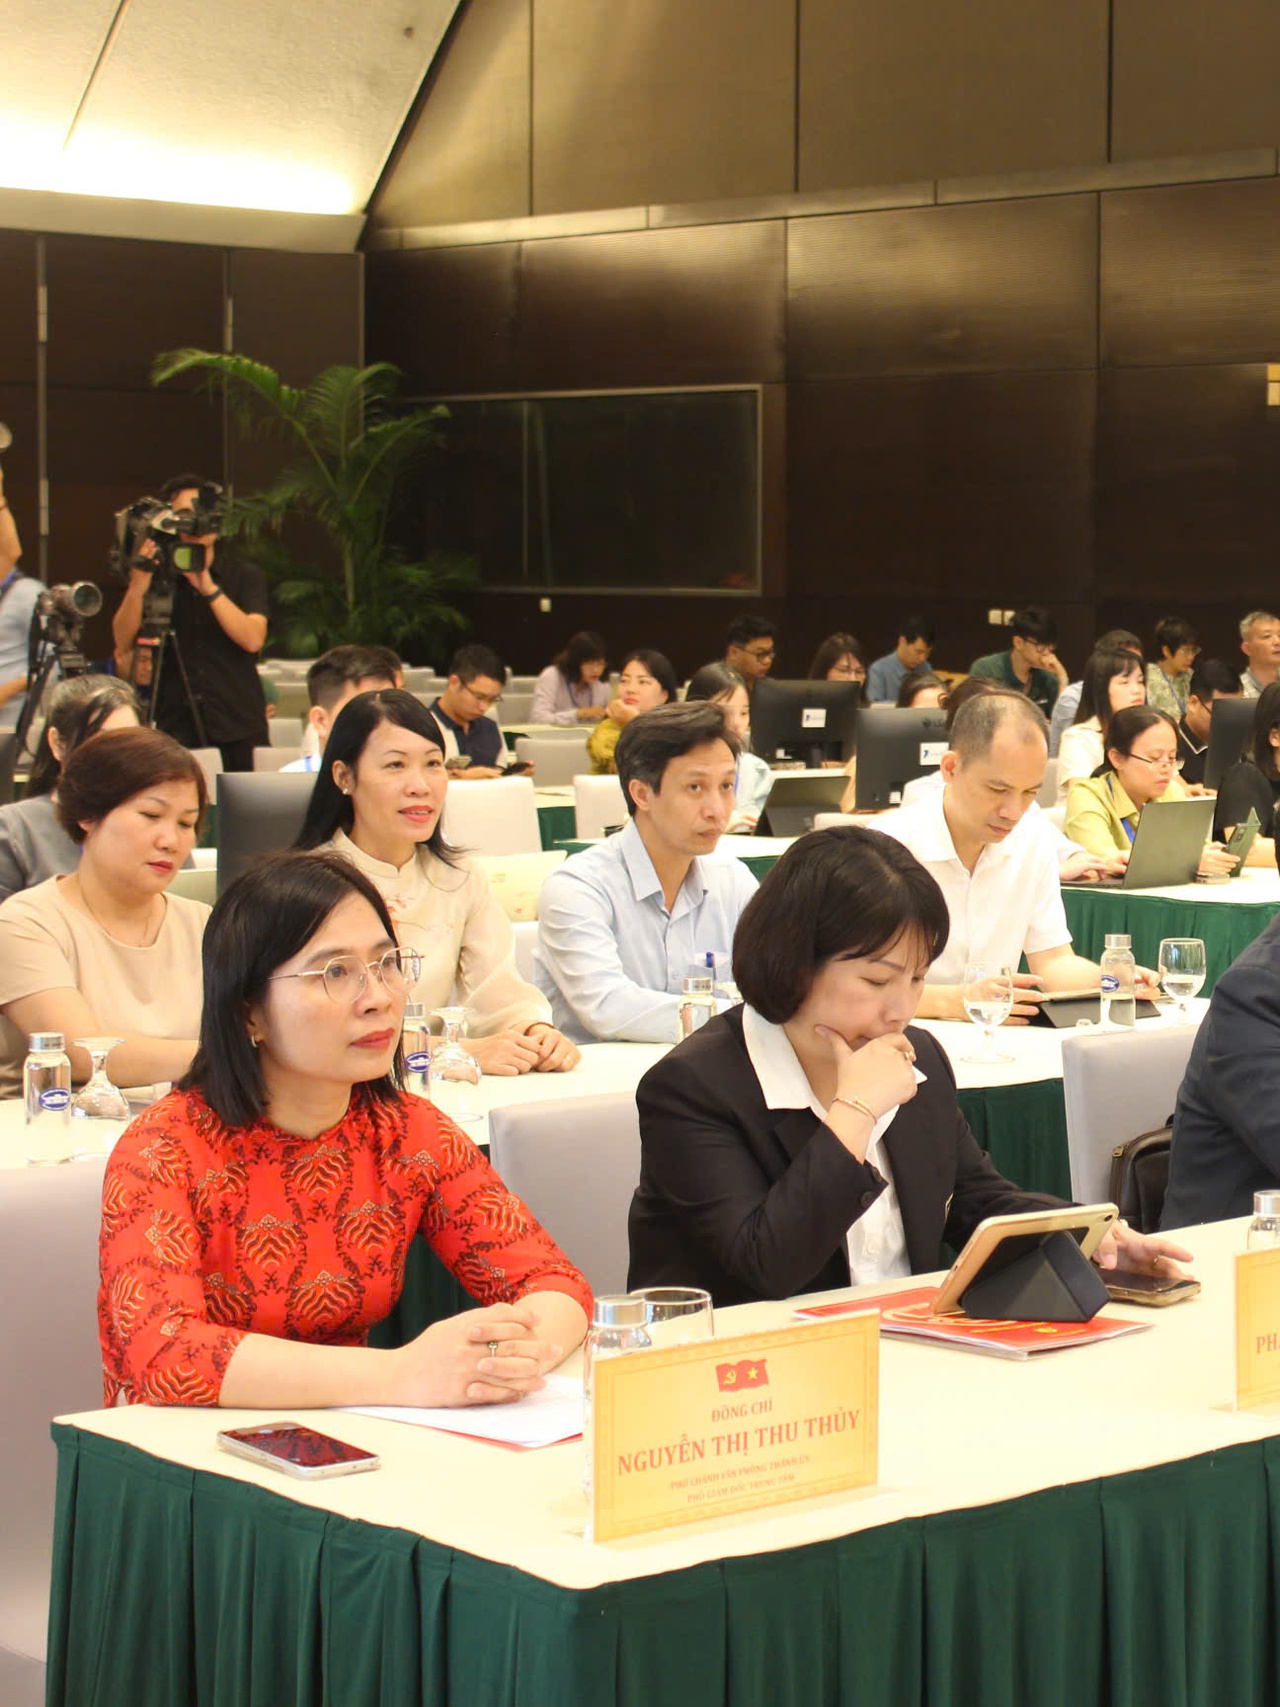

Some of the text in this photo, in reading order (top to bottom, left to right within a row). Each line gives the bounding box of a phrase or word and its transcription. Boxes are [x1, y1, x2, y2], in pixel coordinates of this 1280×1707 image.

[711, 1396, 773, 1422] ĐỒNG CHÍ
[617, 1406, 861, 1476] NGUYỄN THỊ THU THỦY
